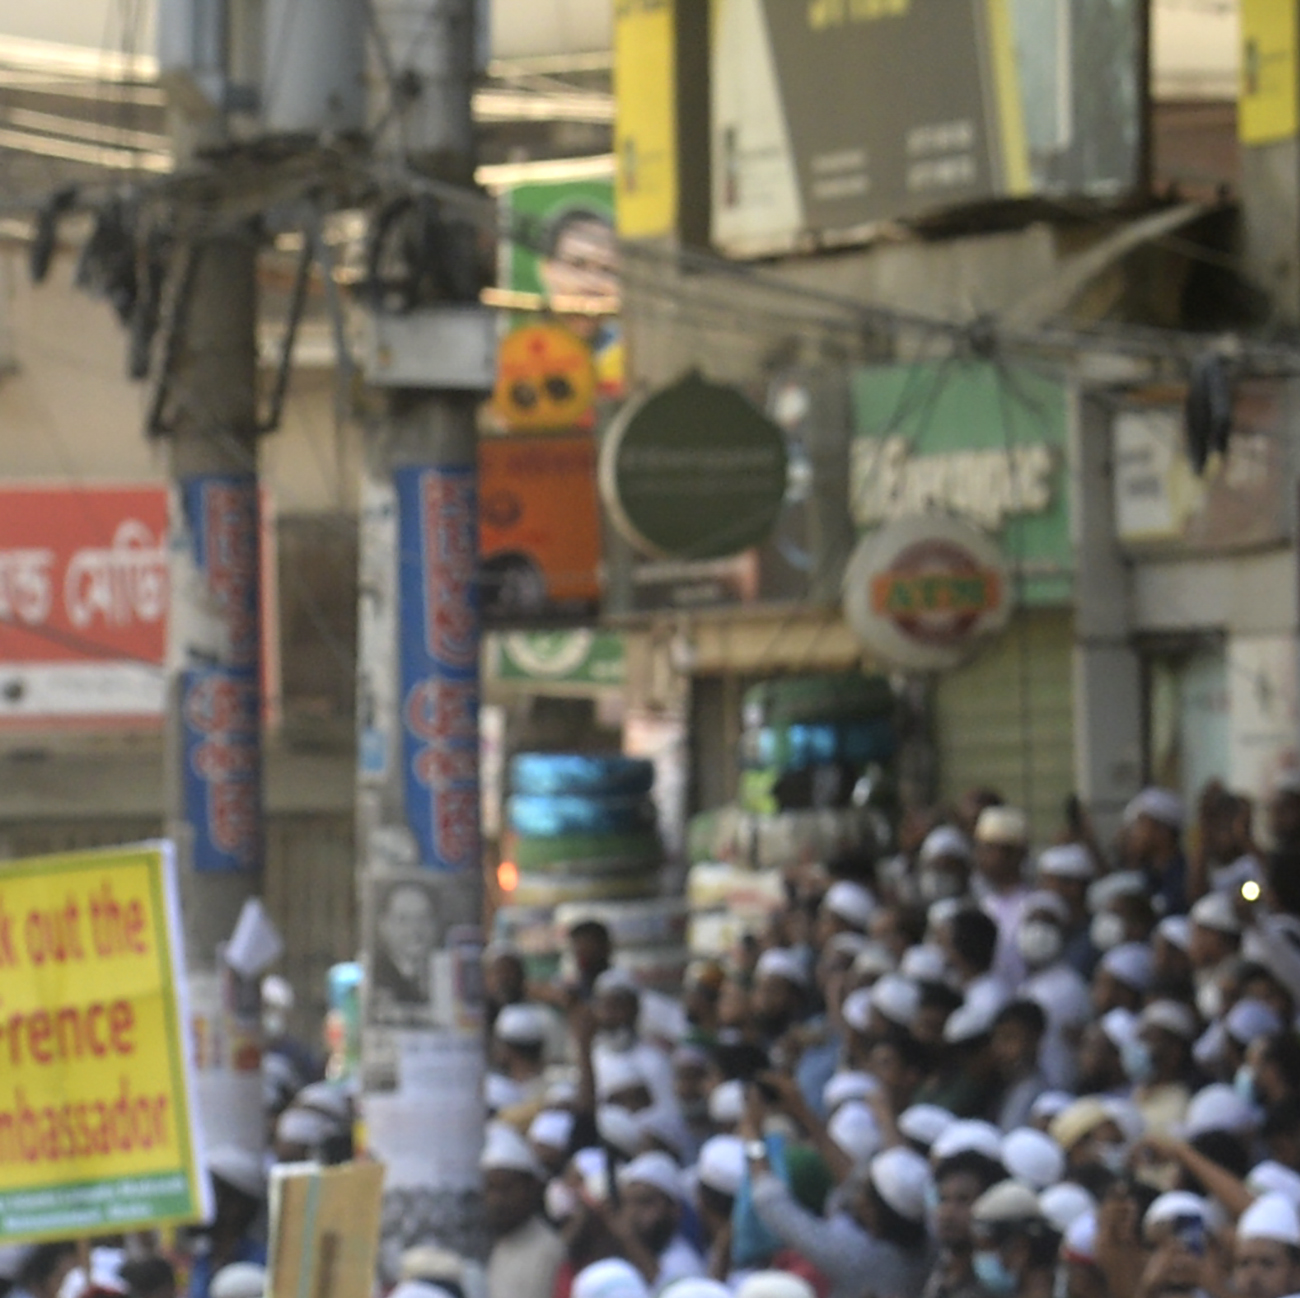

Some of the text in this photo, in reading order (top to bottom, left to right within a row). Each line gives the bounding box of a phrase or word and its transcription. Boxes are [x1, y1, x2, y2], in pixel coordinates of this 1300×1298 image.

[26, 893, 84, 965] out
[88, 875, 147, 957] the
[0, 998, 135, 1066] rence
